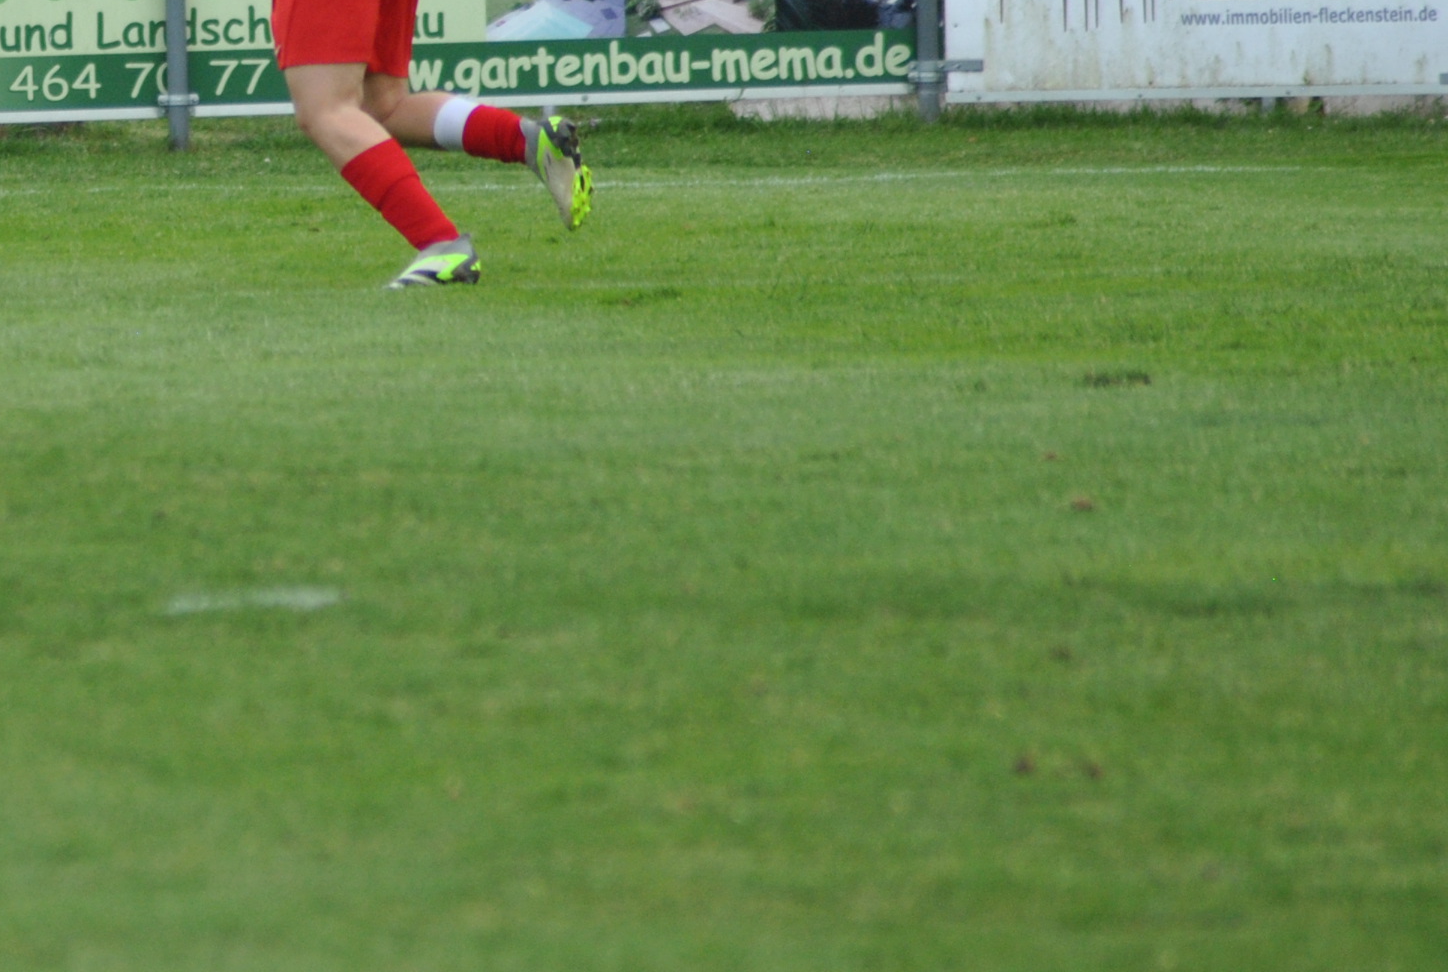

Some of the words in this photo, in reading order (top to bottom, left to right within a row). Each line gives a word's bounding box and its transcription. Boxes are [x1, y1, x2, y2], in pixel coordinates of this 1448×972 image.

[0, 11, 74, 53] und
[1181, 6, 1438, 27] www.immobilien-fleckenstein.de
[9, 61, 102, 102] 464
[209, 58, 271, 96] 77
[408, 32, 912, 96] w.gartenbau-mema.de
